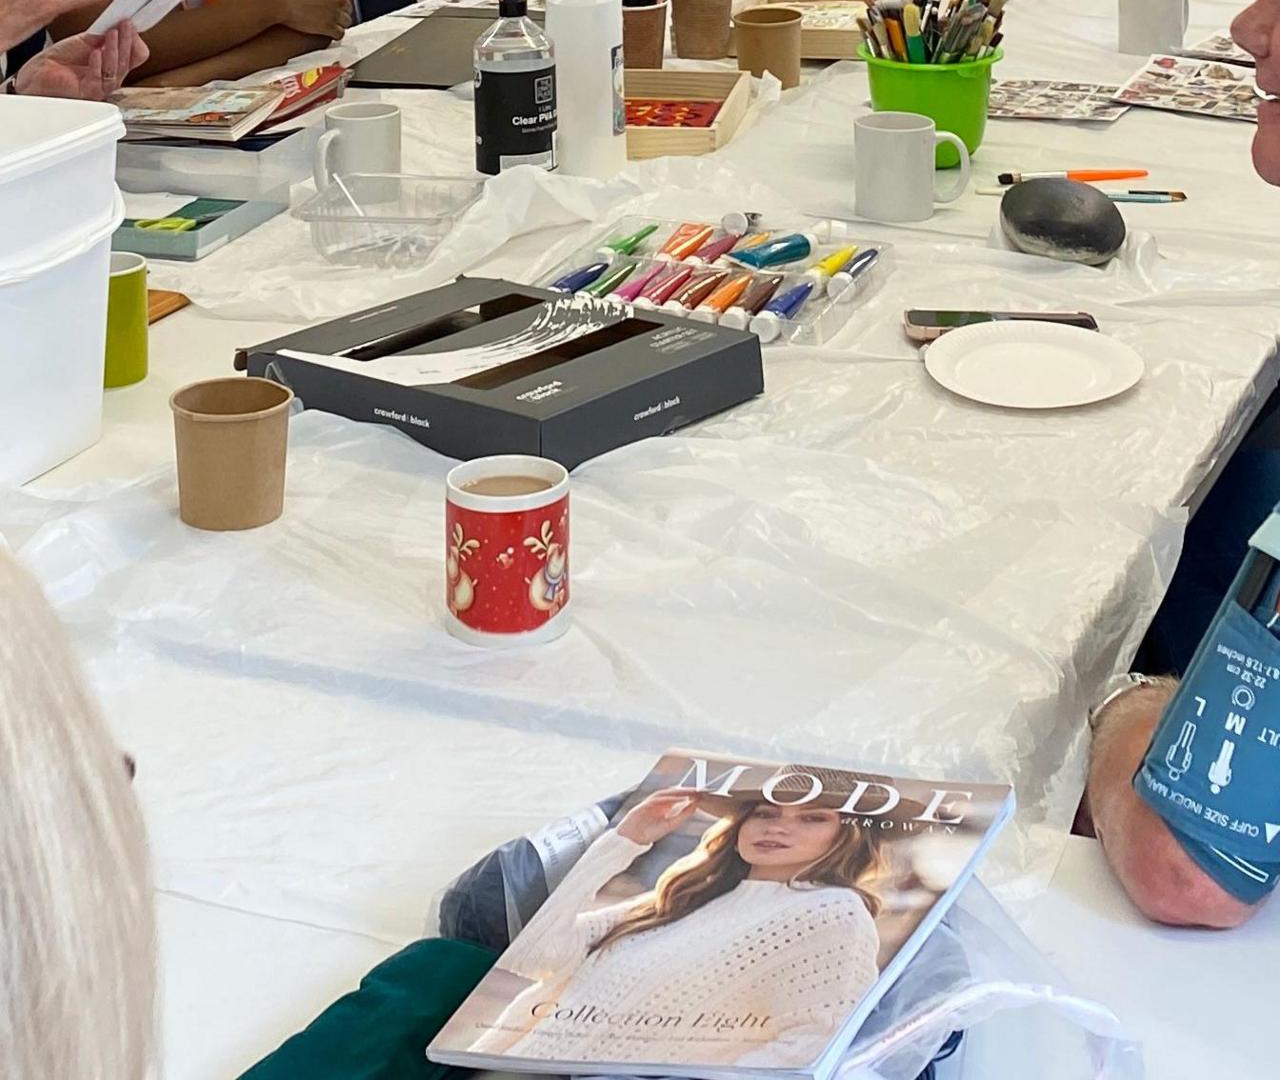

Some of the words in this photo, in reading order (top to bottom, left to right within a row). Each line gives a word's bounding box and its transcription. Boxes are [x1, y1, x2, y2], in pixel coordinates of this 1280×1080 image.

[512, 115, 538, 126] Clear
[538, 111, 553, 123] PVA
[663, 396, 681, 409] black
[410, 415, 430, 428] black
[1216, 644, 1246, 663] inches
[1226, 663, 1240, 676] cm
[1241, 670, 1267, 689] 22-32
[1194, 696, 1207, 717] L
[1224, 711, 1247, 736] M
[675, 758, 973, 825] MODE
[1169, 791, 1202, 815] INDEX
[1203, 807, 1230, 827] SIZE
[861, 819, 958, 835] ROWAN
[1229, 821, 1260, 838] CUFF
[530, 1000, 682, 1029] Collection
[690, 1011, 771, 1034] Eight
